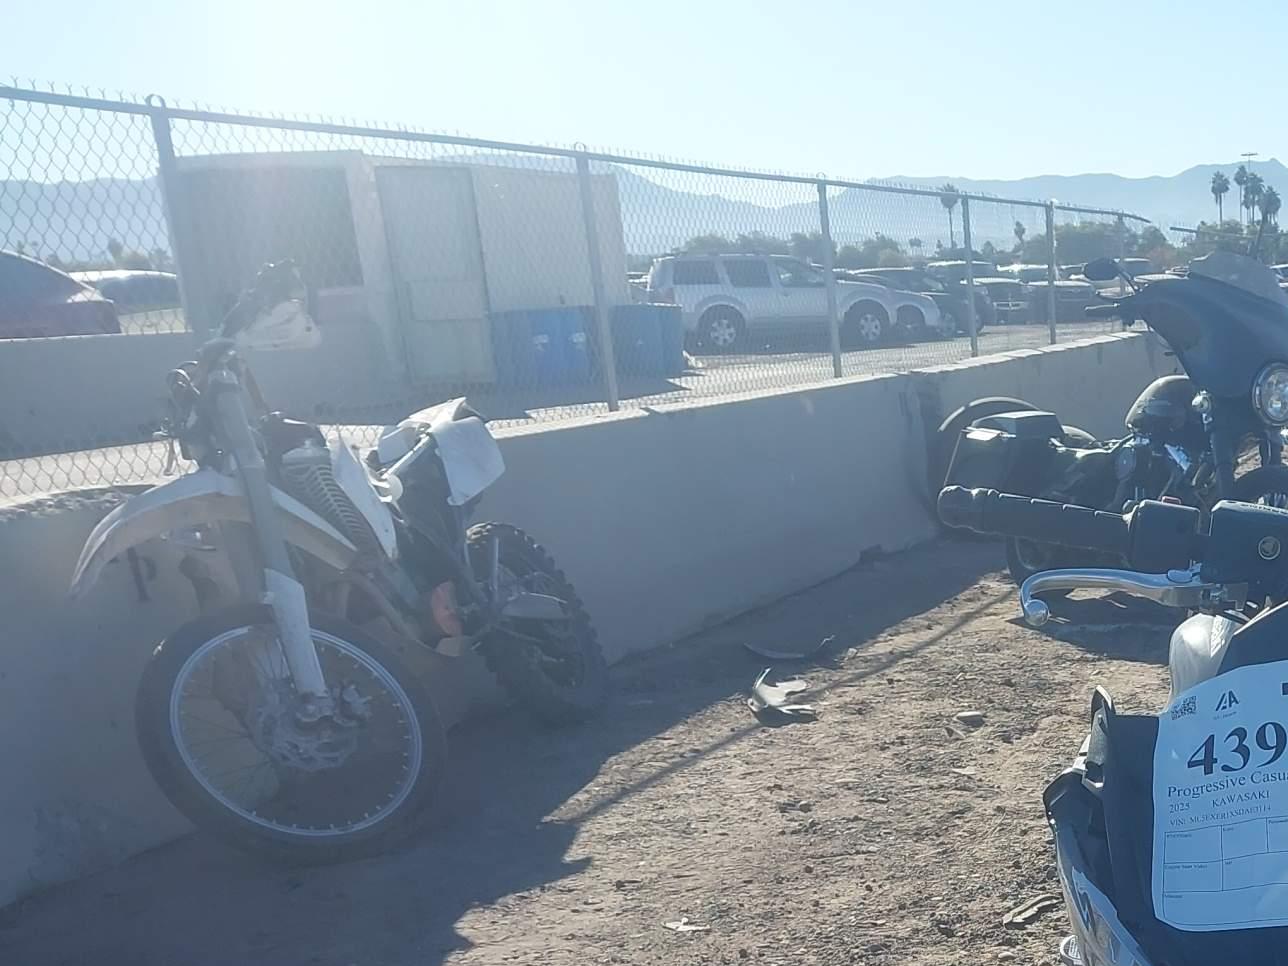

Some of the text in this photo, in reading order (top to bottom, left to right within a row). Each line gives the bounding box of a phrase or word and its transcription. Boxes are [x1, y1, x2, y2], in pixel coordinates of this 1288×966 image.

[1167, 775, 1246, 799] Progressive
[1169, 790, 1270, 814] 2025 KAWASAKI
